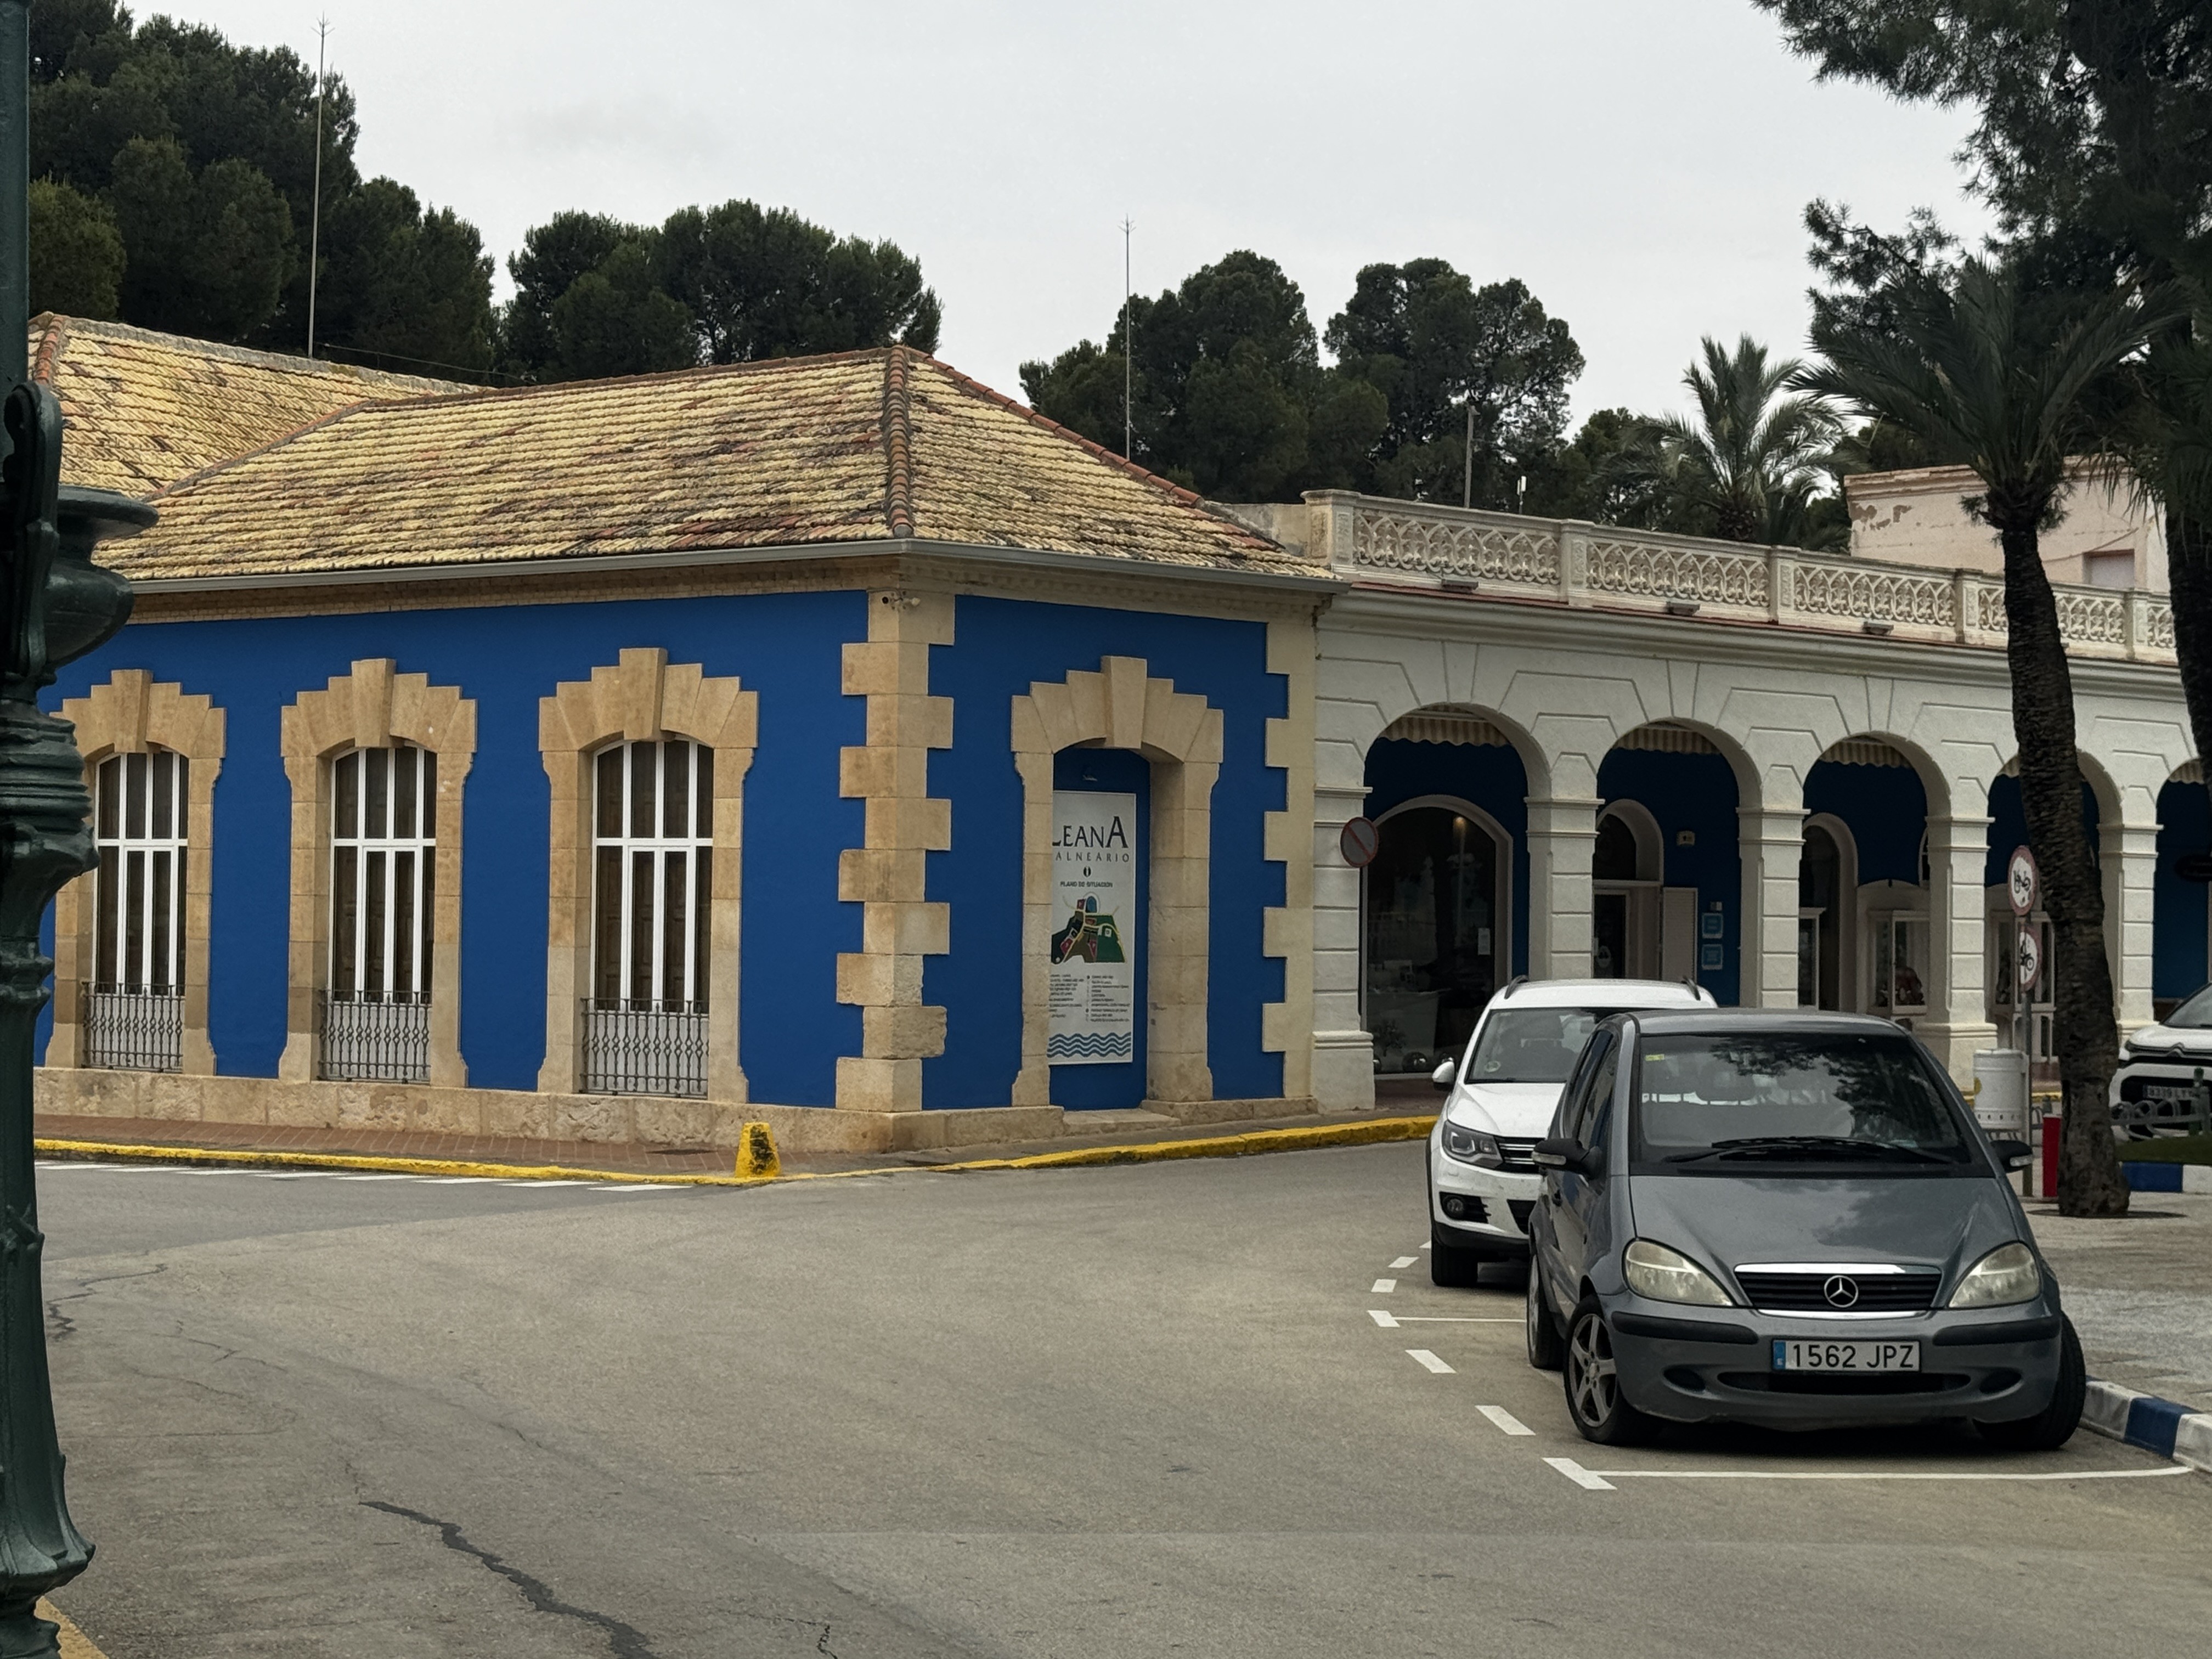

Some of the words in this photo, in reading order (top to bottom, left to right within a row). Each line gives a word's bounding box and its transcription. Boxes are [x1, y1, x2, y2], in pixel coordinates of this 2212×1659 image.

[1056, 851, 1130, 862] ALNEARIO
[1793, 1344, 1857, 1368] 1562
[1866, 1345, 1914, 1368] JPZ
